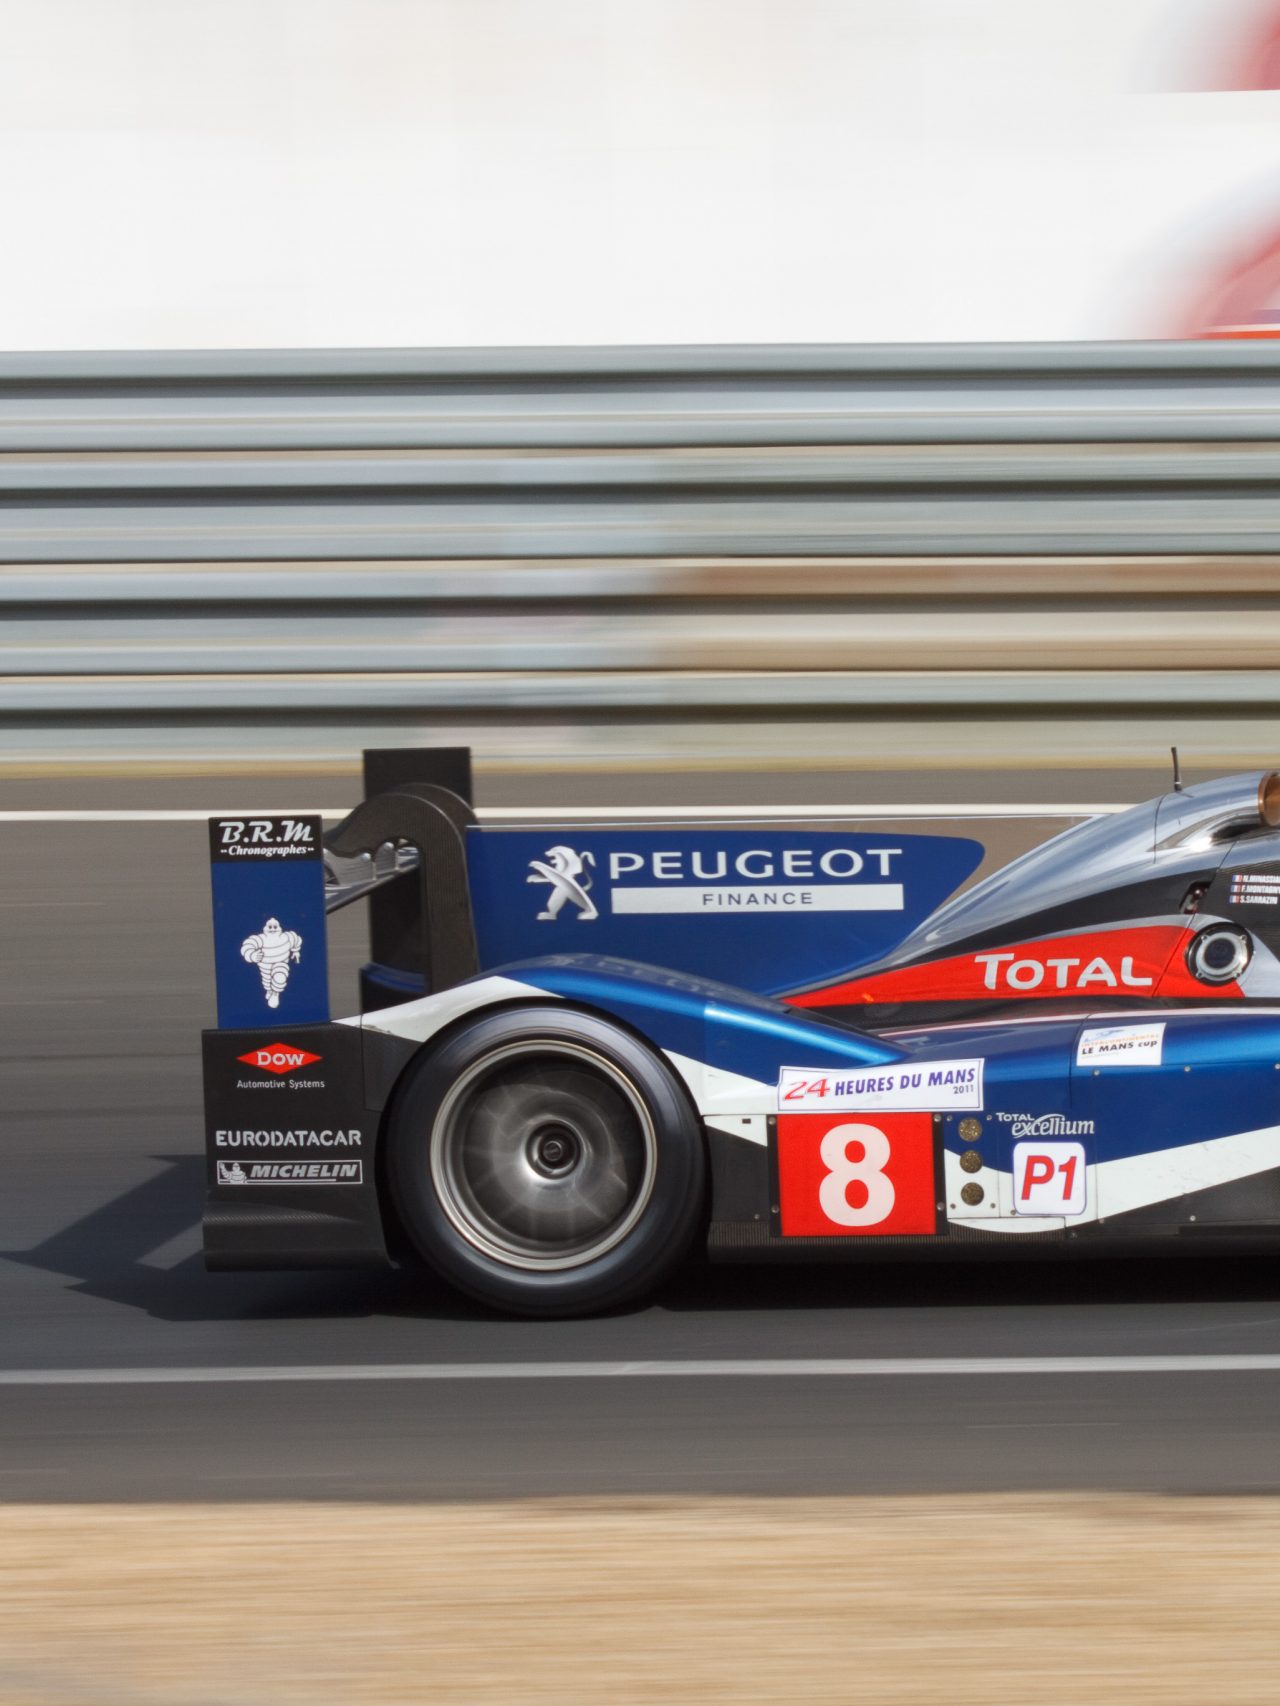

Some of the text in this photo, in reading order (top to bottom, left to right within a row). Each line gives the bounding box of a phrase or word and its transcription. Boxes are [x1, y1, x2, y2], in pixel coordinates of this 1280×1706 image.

[228, 844, 307, 857] Chronographes
[609, 848, 903, 880] PEUGEOT
[701, 891, 814, 906] FINANCE
[974, 953, 1152, 990] TOTAL
[1082, 1047, 1094, 1055] LE
[1099, 1042, 1134, 1052] MANS
[237, 1079, 326, 1090] Automotive Systems
[784, 1068, 976, 1101] 24 HEURES DU MANS
[952, 1084, 975, 1095] 2011
[996, 1112, 1035, 1121] TOTAL
[1011, 1115, 1095, 1138] excellium
[215, 1130, 362, 1147] EURODATACAR
[250, 1164, 358, 1178] MICHELIN
[818, 1123, 896, 1227] 8
[1021, 1155, 1077, 1200] P1
